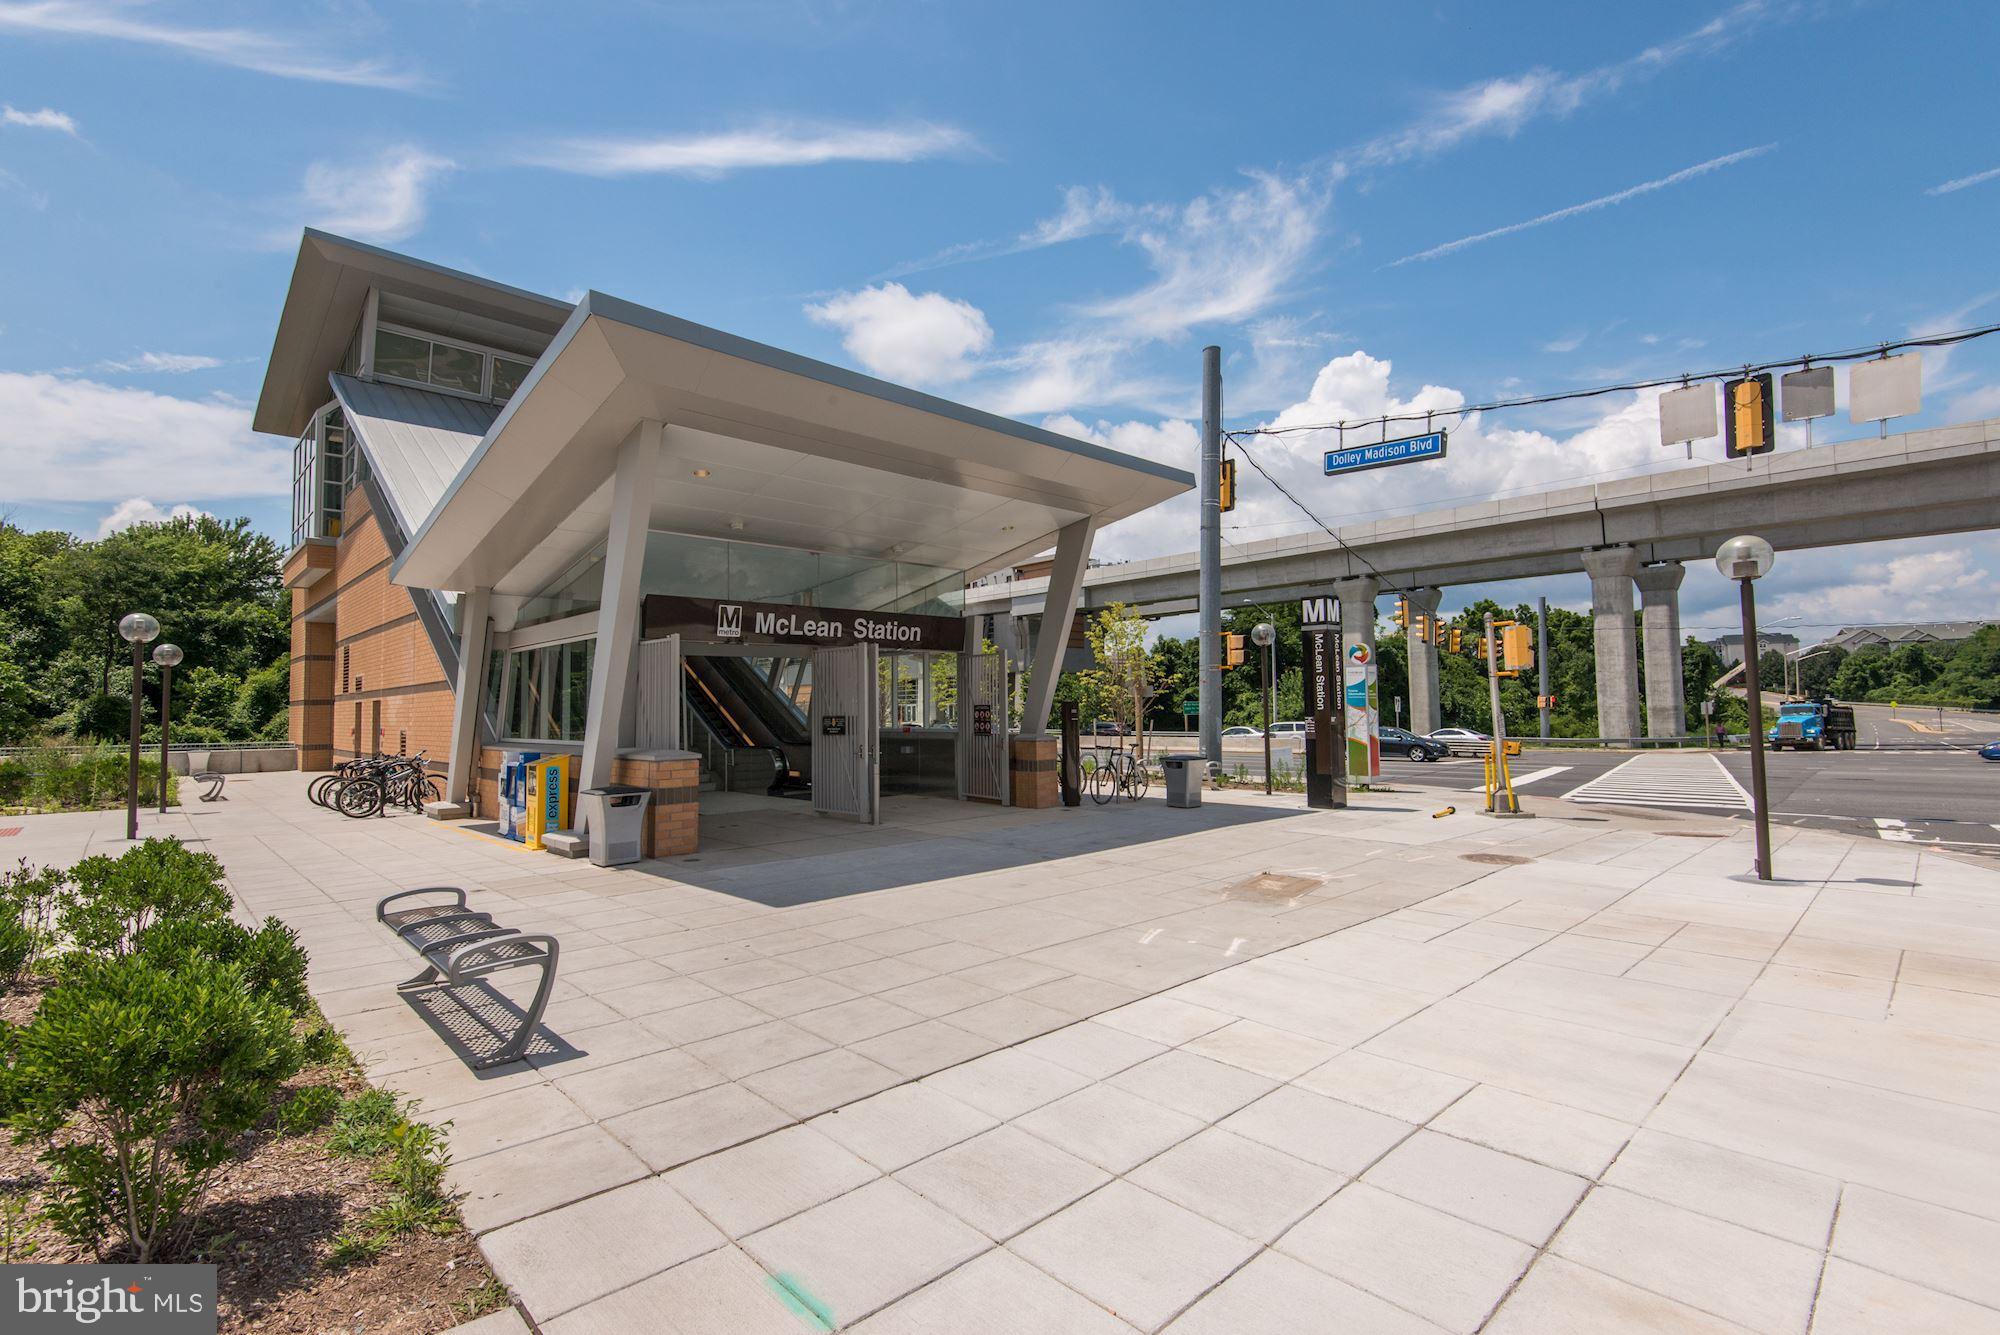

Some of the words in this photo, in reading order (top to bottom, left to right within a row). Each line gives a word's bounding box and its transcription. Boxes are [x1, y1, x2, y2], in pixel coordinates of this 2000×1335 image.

[1332, 452, 1362, 466] Dolley
[1365, 444, 1406, 460] Madison
[1410, 438, 1433, 453] Blvd
[719, 606, 741, 628] M
[1302, 599, 1325, 623] M
[1326, 598, 1340, 623] M
[755, 612, 843, 638] McLean
[853, 617, 922, 642] Station
[1314, 633, 1324, 673] McLean
[1316, 675, 1326, 710] Station
[548, 769, 559, 818] express
